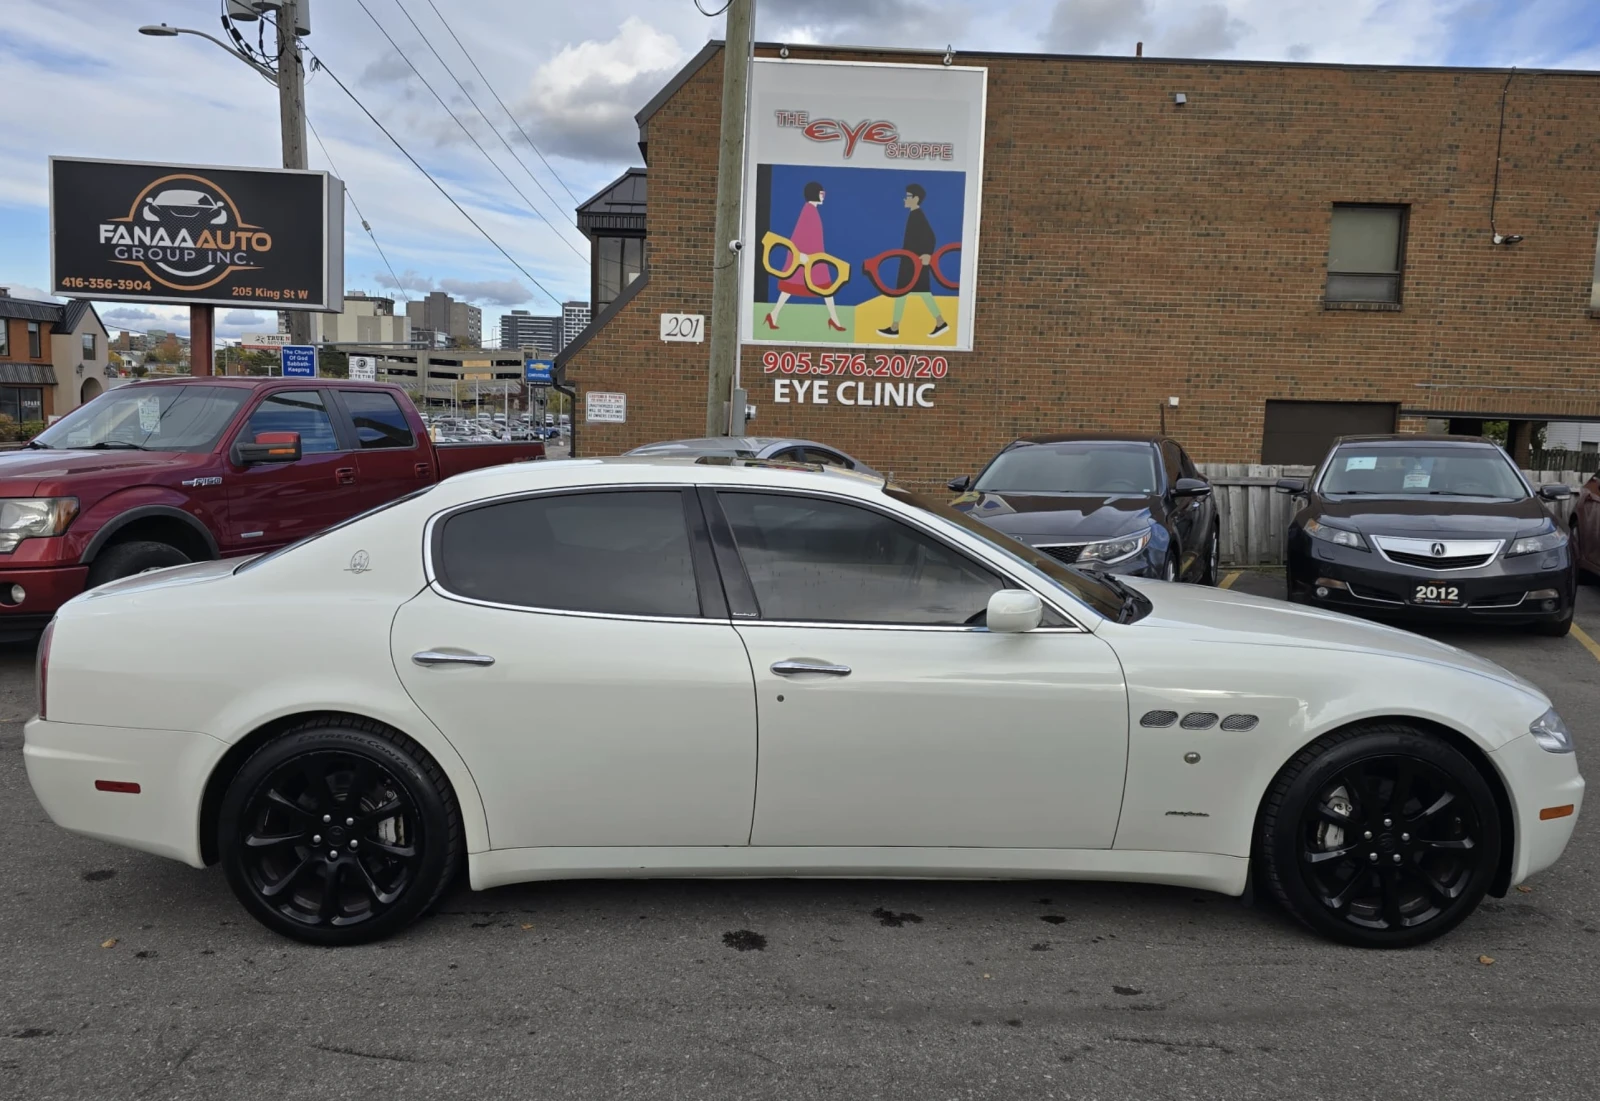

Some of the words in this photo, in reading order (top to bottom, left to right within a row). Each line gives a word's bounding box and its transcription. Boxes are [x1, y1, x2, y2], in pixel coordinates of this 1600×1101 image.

[775, 110, 808, 127] THE
[885, 142, 954, 160] SHOPPE
[114, 246, 196, 262] GROUP
[208, 250, 255, 265] INC.
[61, 277, 152, 292] 416-356-3904
[231, 286, 253, 297] 205
[255, 287, 281, 300] King
[283, 288, 295, 299] St
[297, 289, 309, 299] W
[664, 316, 701, 338] 201
[762, 351, 948, 378] 905.576.20/20
[773, 379, 829, 405] EYE
[836, 381, 936, 408] CLINIC
[1415, 585, 1459, 600] 2012
